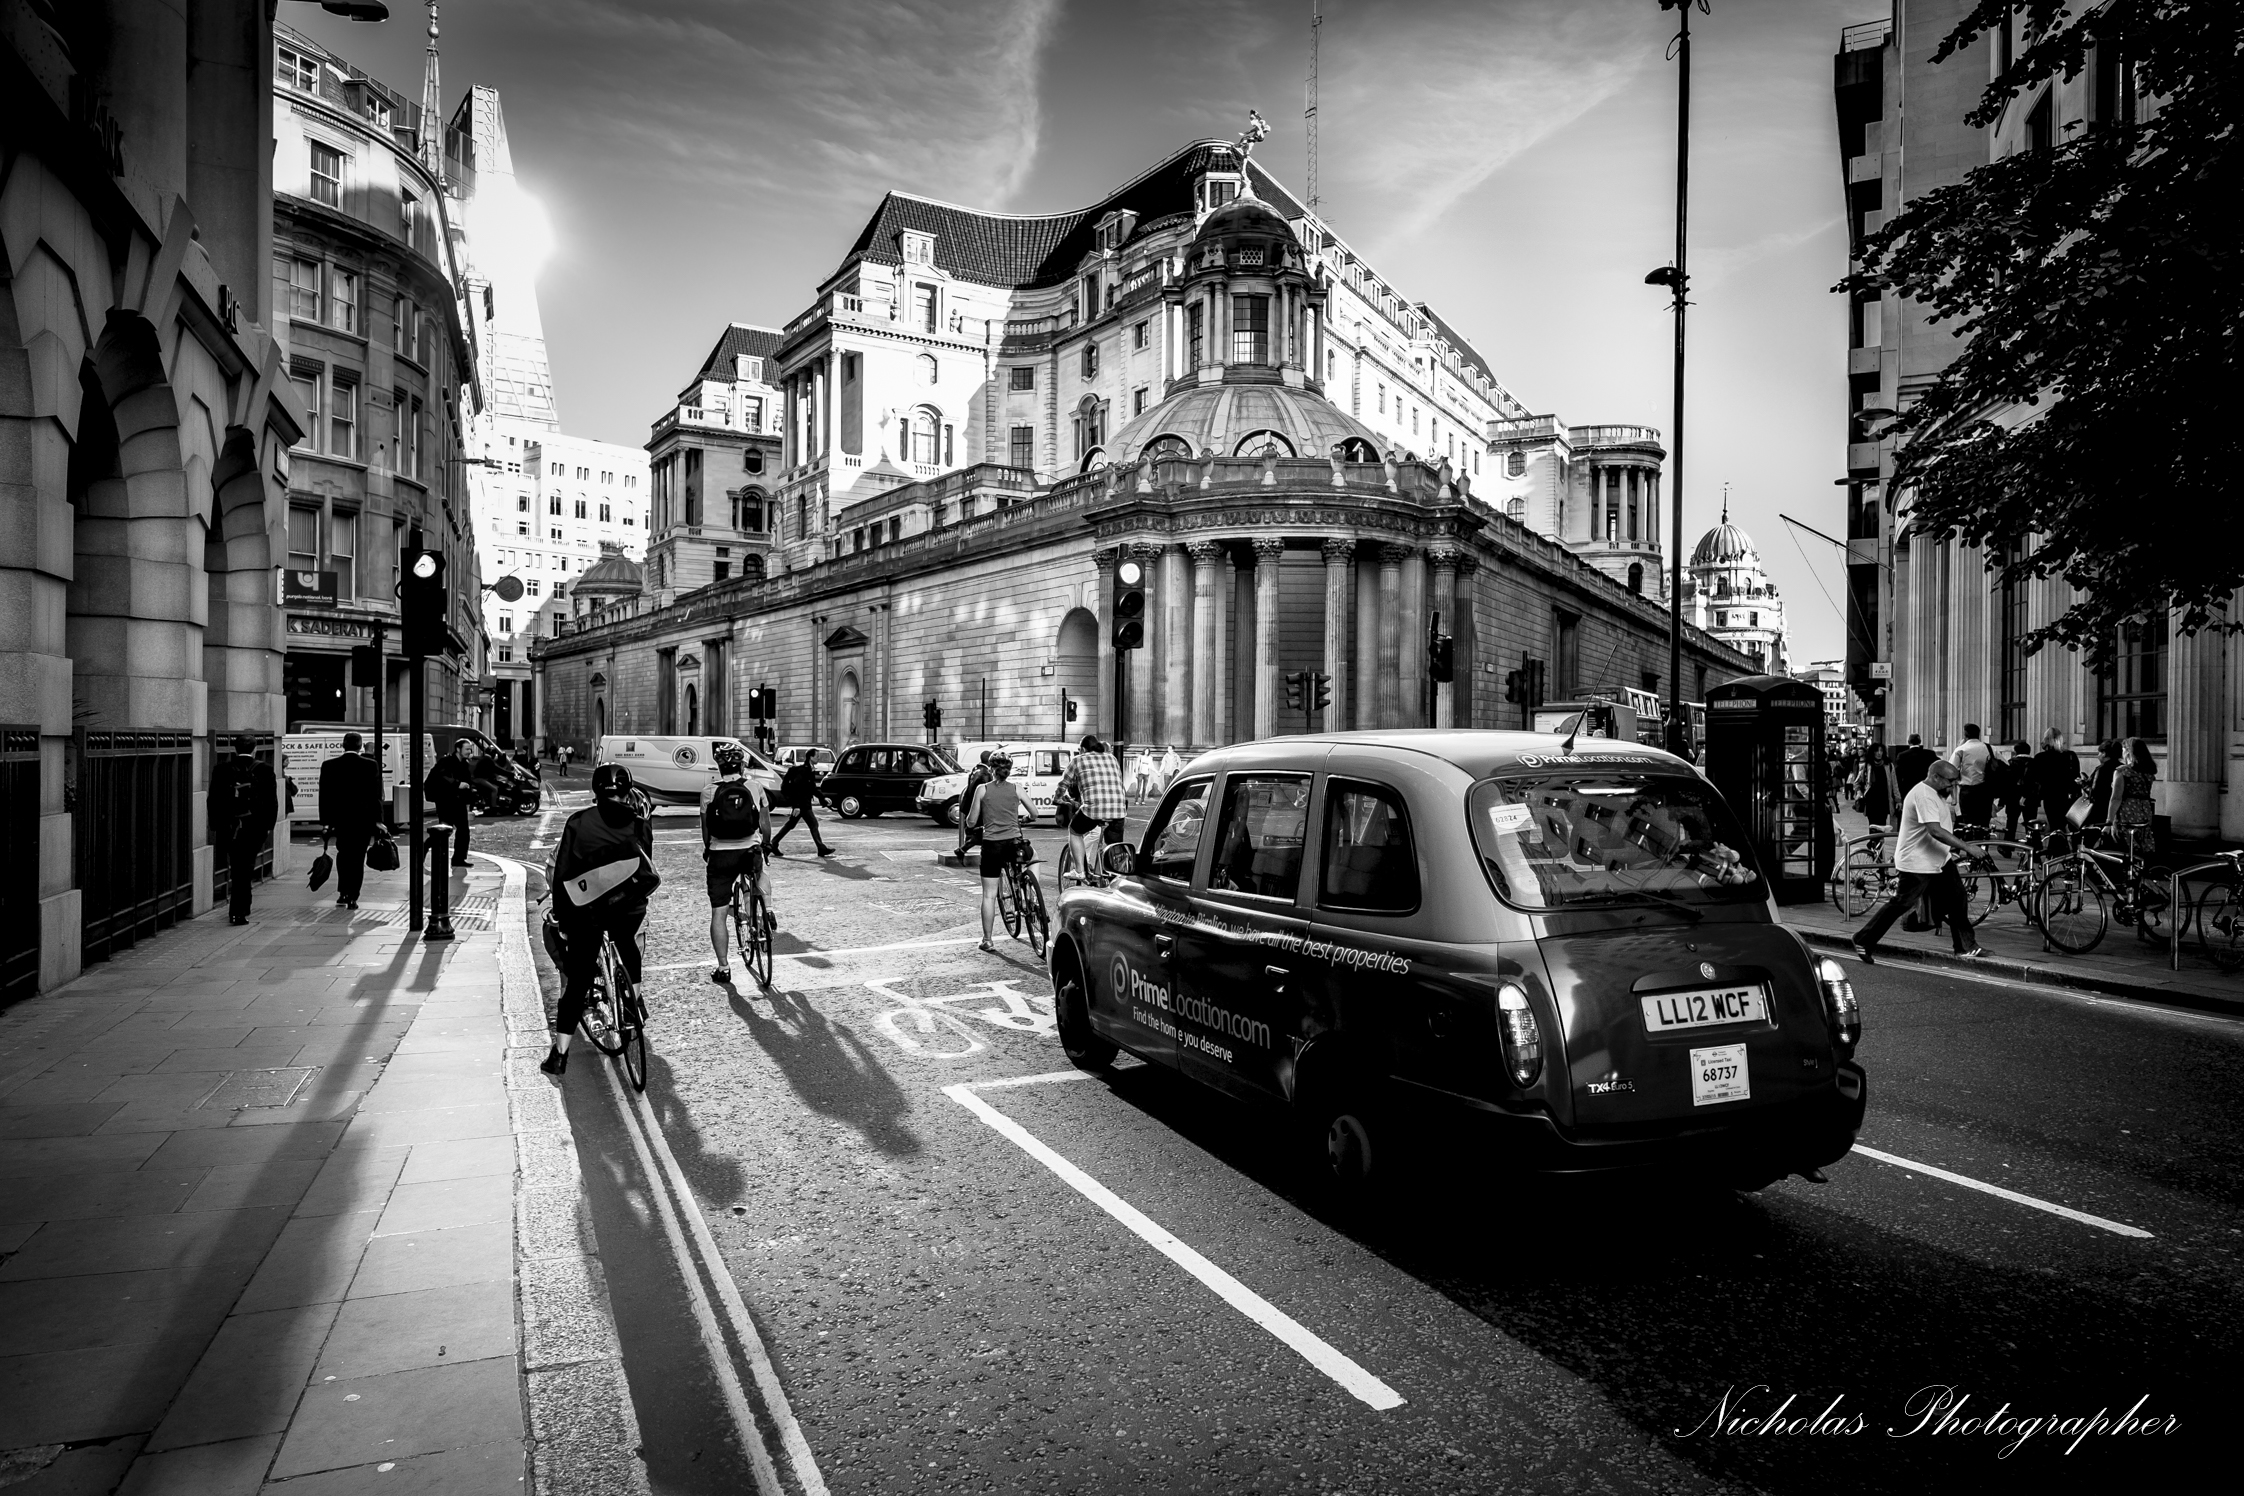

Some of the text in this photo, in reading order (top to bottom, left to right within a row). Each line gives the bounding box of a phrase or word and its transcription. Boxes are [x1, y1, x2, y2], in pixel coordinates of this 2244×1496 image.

[221, 284, 241, 336] PLC
[287, 619, 389, 640] K SADERAT PC
[1715, 699, 1756, 709] TELEPHONE
[1771, 700, 1815, 708] TELEPHONE
[1230, 923, 1245, 939] we
[1246, 921, 1266, 946] have
[1267, 929, 1283, 949] all
[1281, 930, 1301, 953] the
[1302, 934, 1334, 961] best
[1331, 946, 1413, 976] properties
[1130, 968, 1271, 1051] PrimeLocation.com
[1656, 991, 1750, 1026] LL12 WCF
[1133, 1006, 1147, 1025] Find
[1148, 1012, 1159, 1031] the
[1184, 1032, 1199, 1048] you
[1200, 1035, 1233, 1064] deserve
[1588, 1080, 1633, 1093] TX4 Euro 5
[1702, 1065, 1738, 1082] 68737
